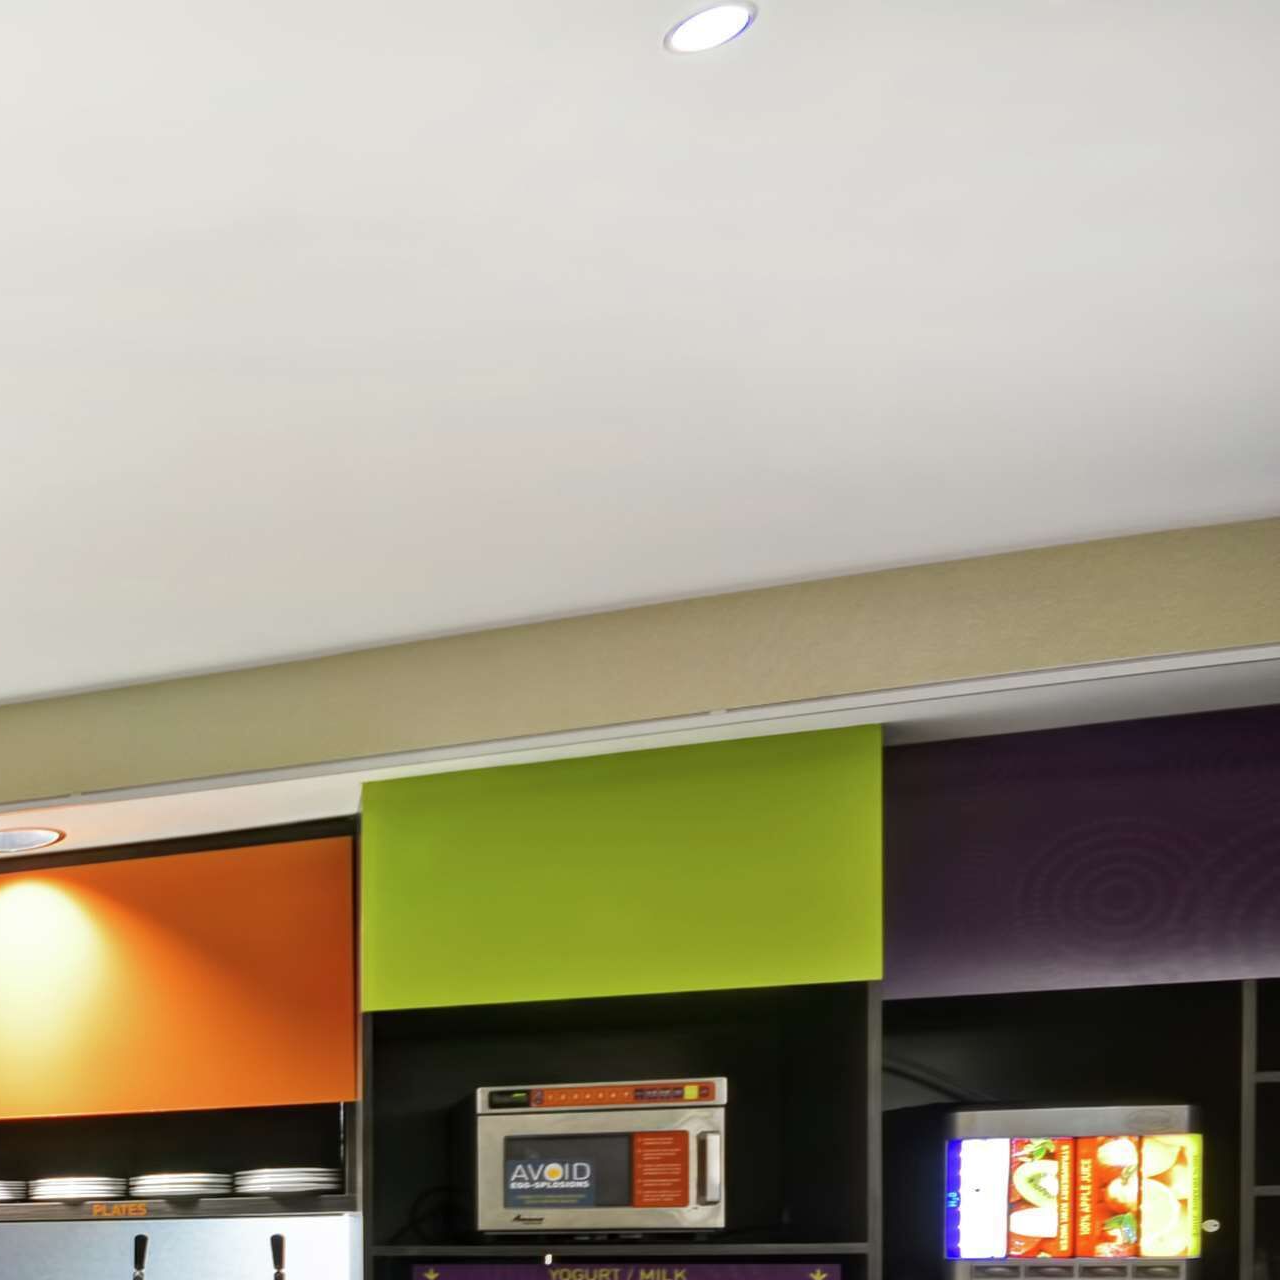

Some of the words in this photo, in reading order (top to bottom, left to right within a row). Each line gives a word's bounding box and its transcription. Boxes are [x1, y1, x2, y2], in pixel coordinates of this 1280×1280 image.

[511, 1162, 591, 1181] AVOID
[1080, 1158, 1092, 1183] JUICE
[93, 1203, 147, 1217] PLATES
[1080, 1185, 1092, 1213] APPLE
